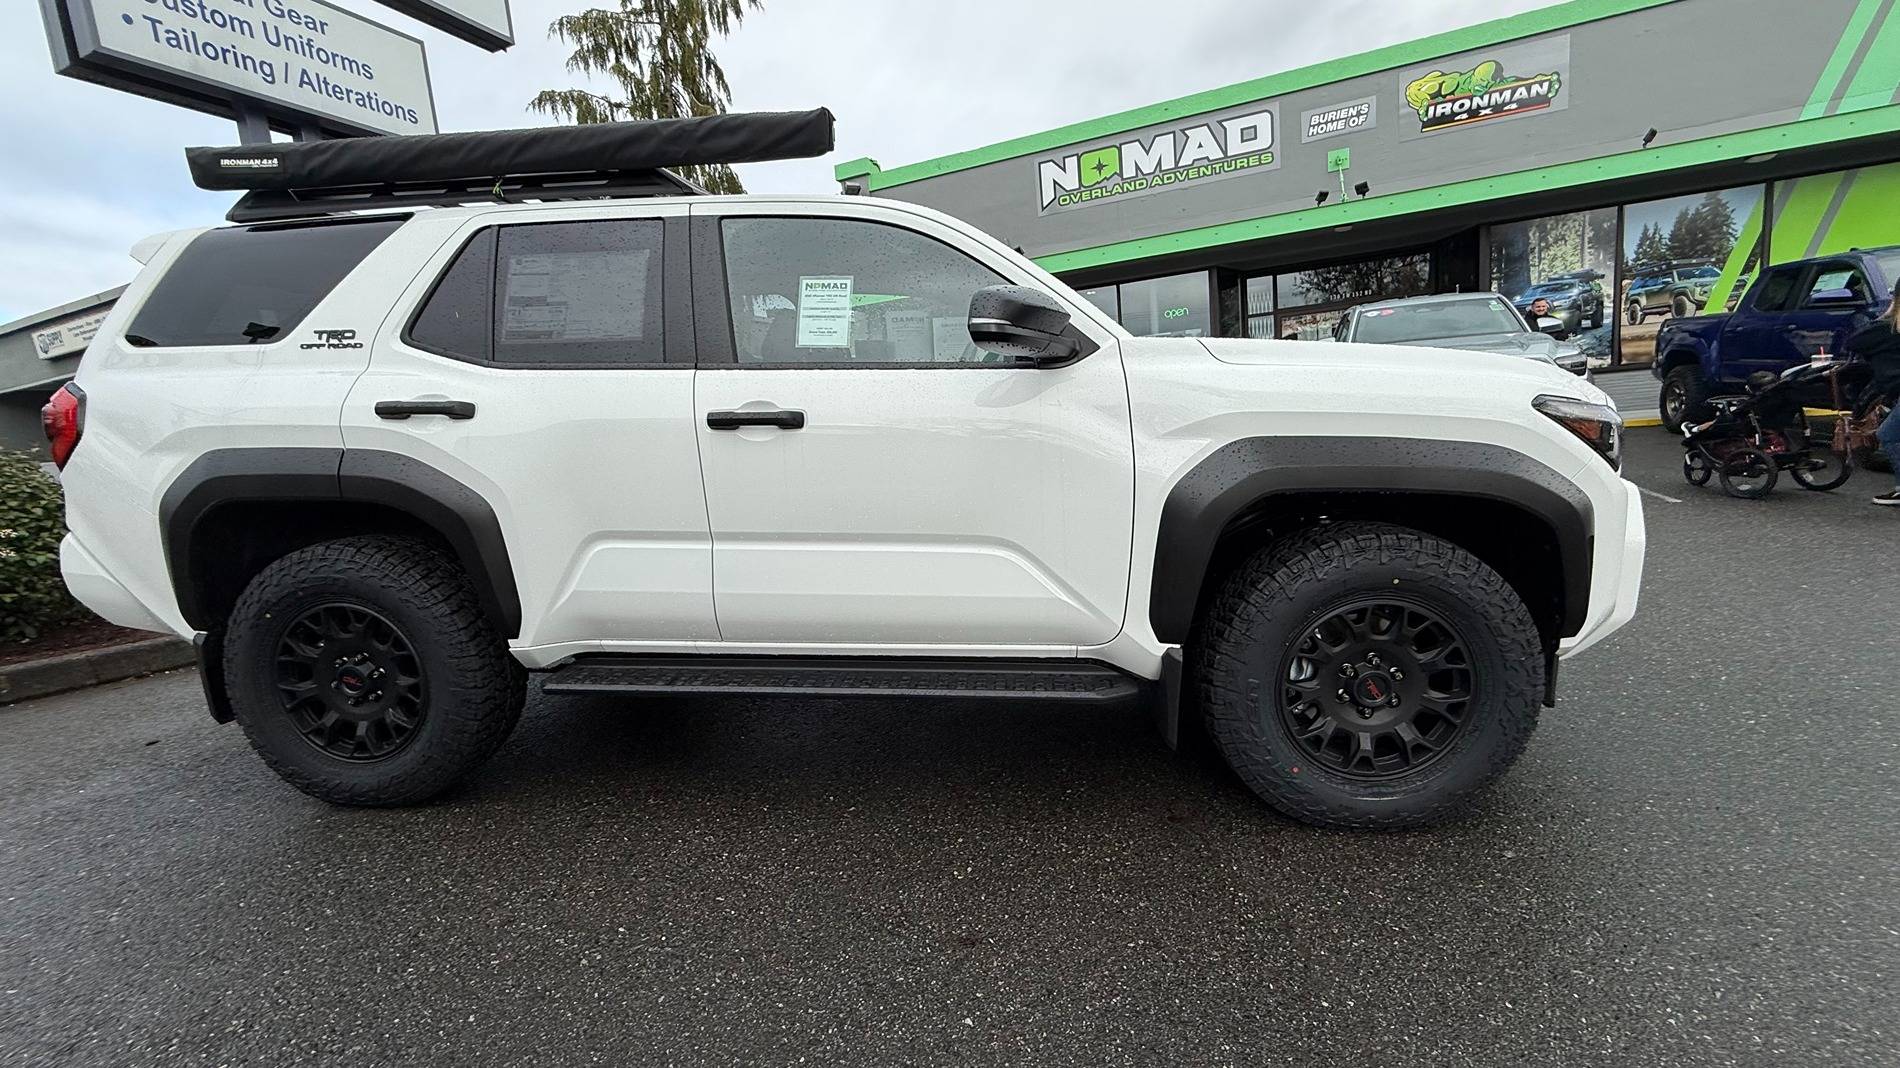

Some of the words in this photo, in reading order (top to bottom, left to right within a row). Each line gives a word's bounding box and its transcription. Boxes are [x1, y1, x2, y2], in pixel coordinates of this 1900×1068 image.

[263, 0, 329, 35] Gear
[145, 0, 255, 39] ustom
[262, 21, 374, 80] Uniforms
[142, 14, 276, 85] Tailoring
[298, 68, 419, 125] Alterations
[1427, 81, 1550, 119] IRONMAN
[1308, 119, 1347, 137] HOME
[1348, 114, 1367, 127] OF
[1310, 103, 1370, 126] BURIEN'S
[220, 158, 261, 166] IRONMAN
[261, 157, 279, 165] 4x4
[1039, 110, 1274, 211] NOMAD
[1058, 178, 1148, 206] OVERLAND
[1150, 152, 1274, 187] ADVENTURES
[805, 282, 848, 291] NOMAD
[1164, 307, 1189, 320] open
[313, 329, 356, 343] TRD
[327, 342, 364, 350] ROAD
